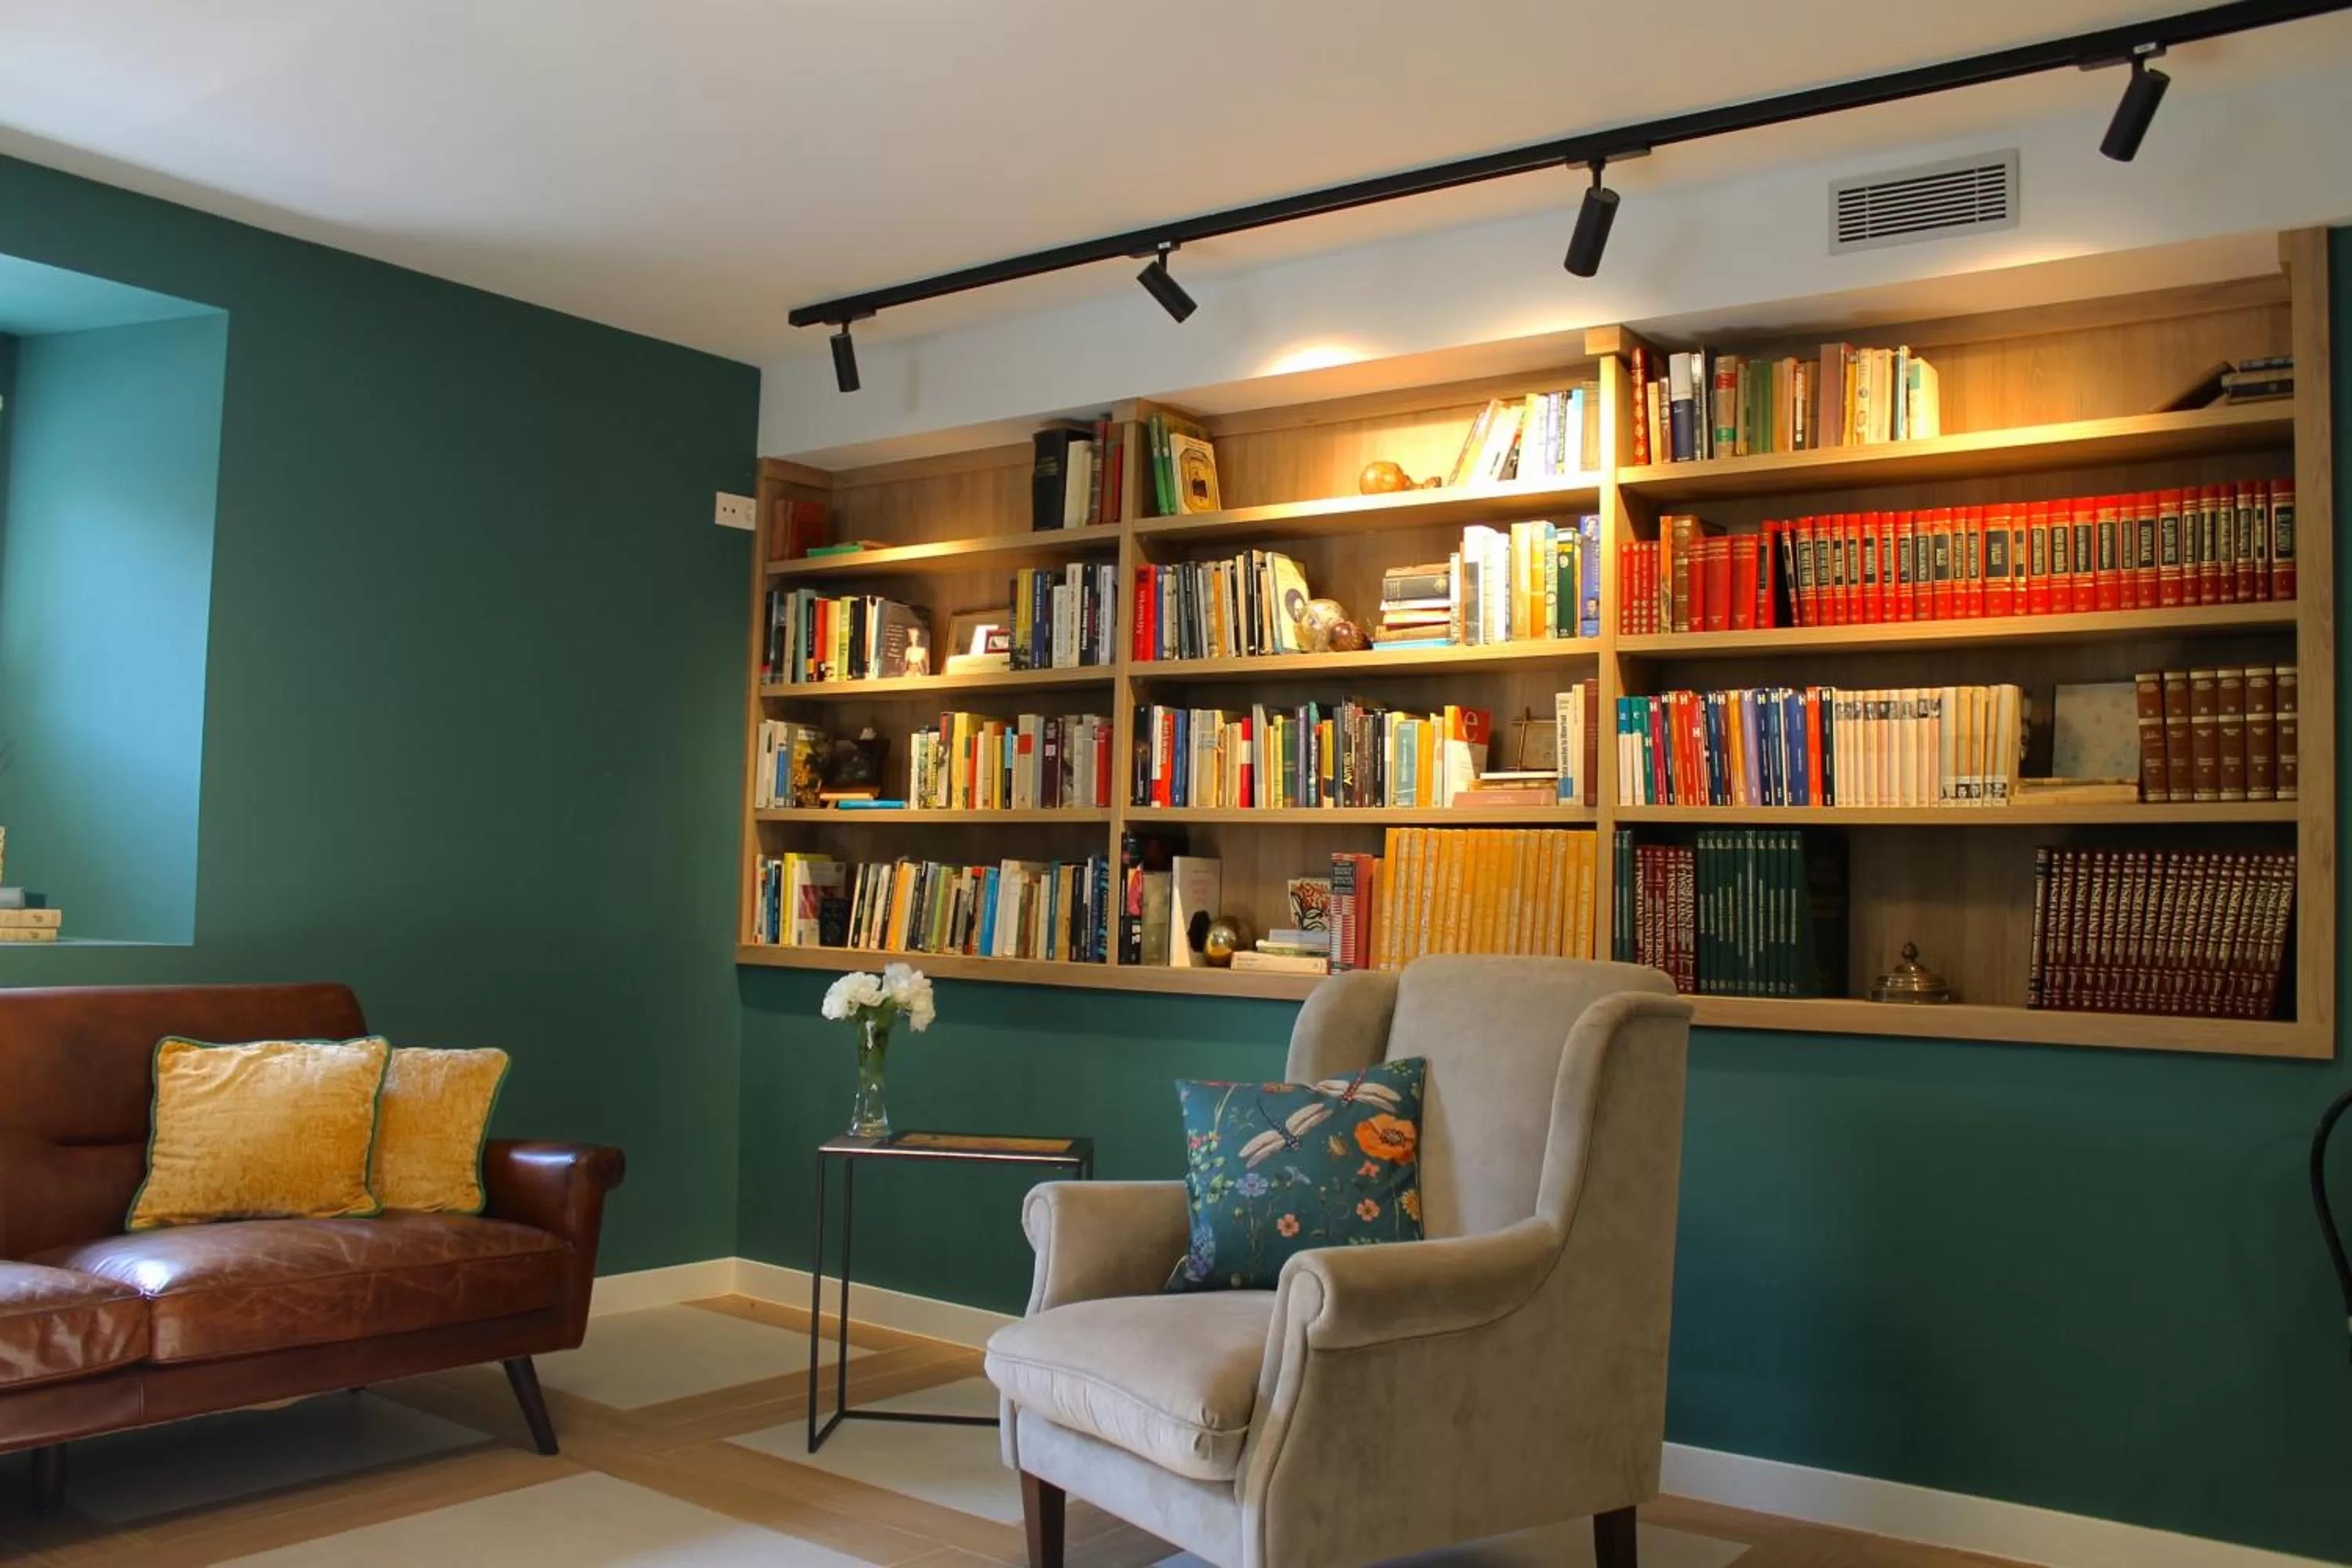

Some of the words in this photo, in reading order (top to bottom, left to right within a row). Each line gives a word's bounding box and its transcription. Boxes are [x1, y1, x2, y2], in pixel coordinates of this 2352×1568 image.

[1680, 695, 1688, 706] H
[1757, 694, 1766, 705] H
[1771, 692, 1779, 703] H
[1807, 690, 1817, 702] H
[1822, 690, 1831, 702] H
[1462, 711, 1479, 742] e
[1693, 728, 1700, 737] H
